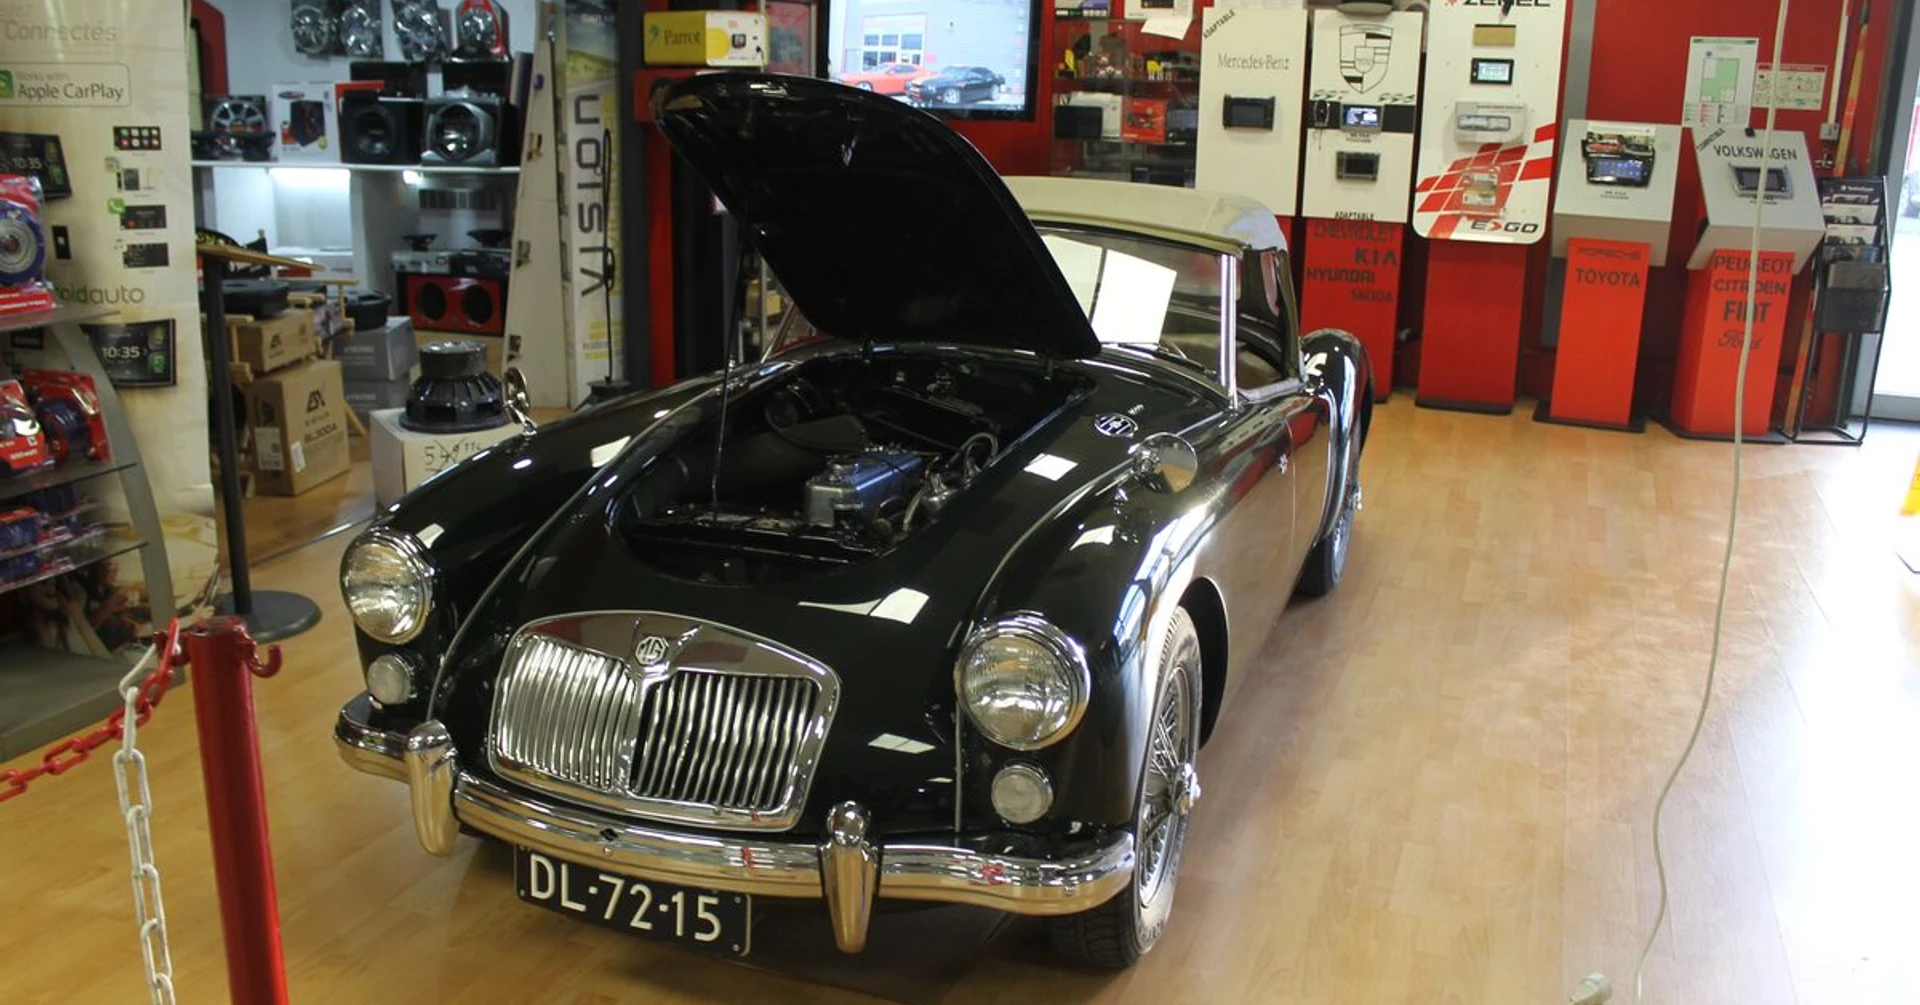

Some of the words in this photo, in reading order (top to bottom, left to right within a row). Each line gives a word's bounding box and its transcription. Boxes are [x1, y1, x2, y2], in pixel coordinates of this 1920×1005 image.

[5, 20, 116, 40] Connectés
[664, 29, 701, 45] Parrot
[1217, 53, 1290, 70] Mercedes-Benz
[19, 83, 59, 101] Apple
[63, 83, 124, 102] CarPlay
[1714, 145, 1798, 160] VOLKSWGEN
[574, 93, 605, 297] VISION
[1354, 247, 1397, 267] KIA
[1305, 267, 1376, 284] HYUNDAI
[1575, 267, 1640, 288] TOYOTA
[103, 346, 140, 359] 10:35
[638, 637, 667, 660] MG
[530, 853, 722, 942] DL-72-15
